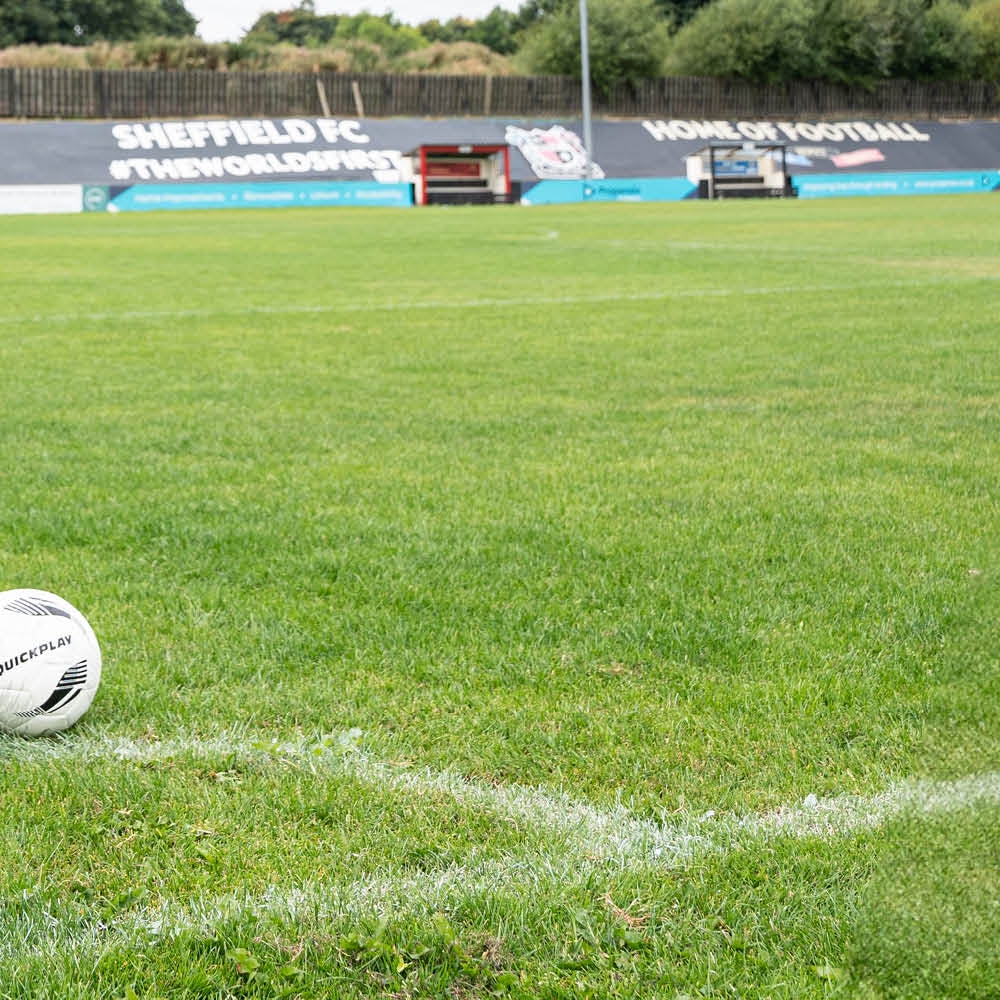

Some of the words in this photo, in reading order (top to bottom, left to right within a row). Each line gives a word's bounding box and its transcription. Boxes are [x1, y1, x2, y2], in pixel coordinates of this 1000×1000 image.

[111, 119, 317, 149] SHEFFIELD
[316, 119, 370, 144] FC
[642, 120, 741, 141] HOME
[736, 121, 777, 141] OF
[775, 121, 930, 141] FOOTBALL
[109, 150, 401, 180] #THEWORLDSFIRST
